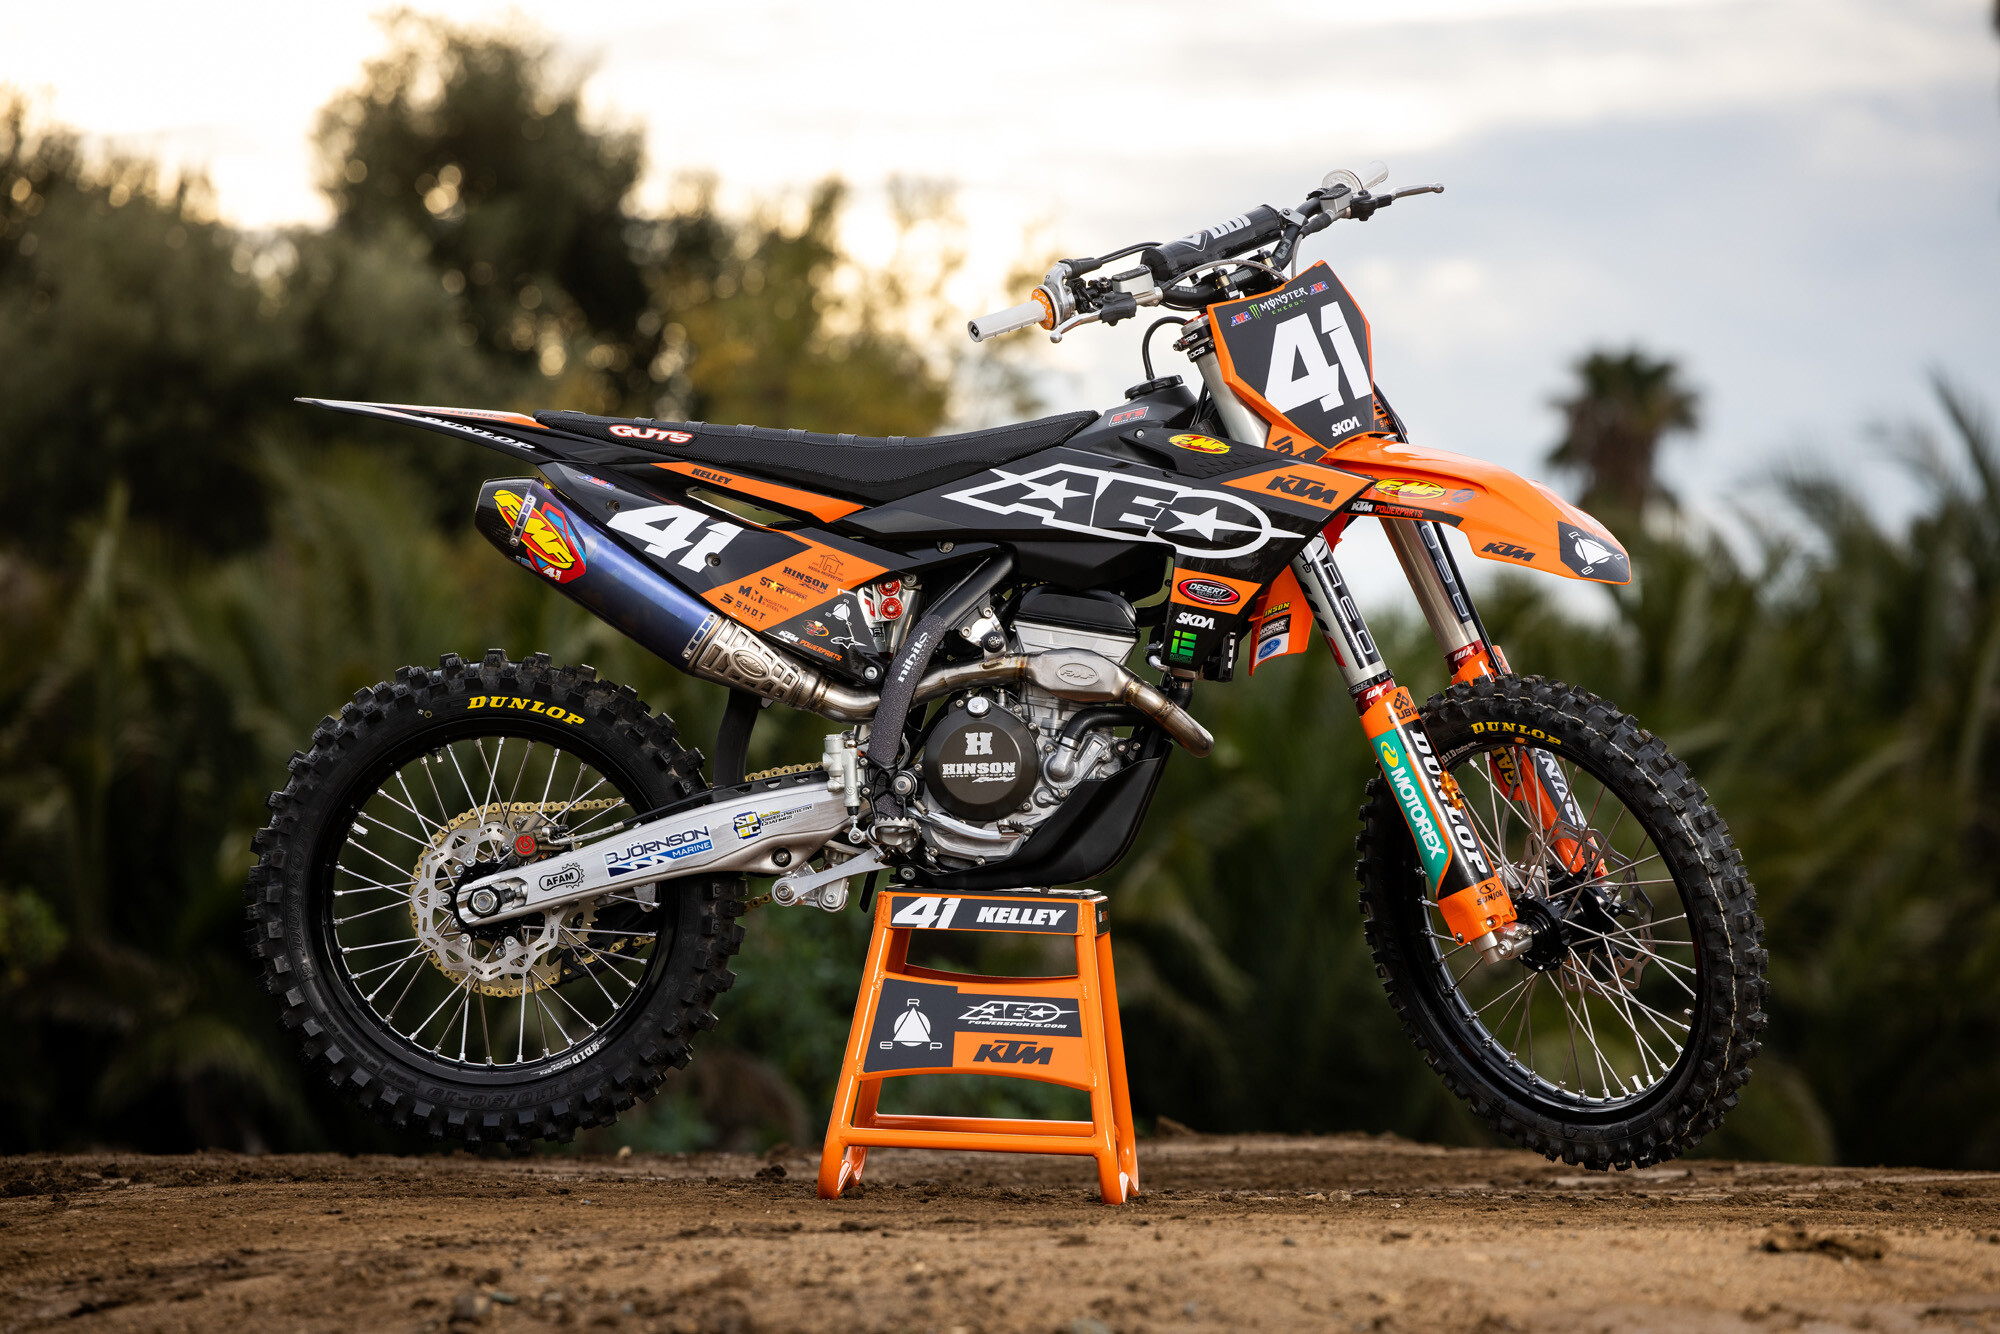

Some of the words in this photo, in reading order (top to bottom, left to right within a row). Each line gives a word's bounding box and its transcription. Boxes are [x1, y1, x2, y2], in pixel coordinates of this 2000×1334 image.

[1264, 301, 1373, 414] 41
[424, 416, 535, 449] DUNLOP
[609, 424, 693, 443] GUTS
[1331, 416, 1361, 437] SKDA
[1169, 434, 1231, 454] FMF
[691, 468, 733, 484] KELLEY
[1265, 474, 1339, 504] KTM
[1374, 478, 1447, 499] FMF
[1351, 500, 1373, 513] KTM
[1374, 504, 1423, 518] POWERPARTS
[493, 491, 576, 564] FMF
[606, 504, 744, 573] 41
[1480, 541, 1536, 562] KTM
[782, 566, 829, 590] HINSON
[1188, 583, 1227, 597] DESERT
[735, 600, 766, 620] SHOT
[1264, 602, 1290, 617] INSON
[1323, 562, 1374, 655] AEO
[1175, 611, 1215, 630] SKDA
[799, 639, 843, 661] POWERPARTS
[898, 632, 928, 683] nihilo
[467, 695, 586, 725] DUNLOP
[964, 732, 993, 756] H
[1470, 721, 1562, 746] DUNLOP
[942, 762, 1016, 775] HINSON
[1390, 766, 1446, 861] MOTOREX
[605, 826, 709, 864] BJÖRNSON
[672, 840, 711, 858] MARINE
[546, 871, 574, 887] AFAM
[1476, 889, 1504, 906] SUNJOE
[891, 897, 962, 928] 41
[976, 907, 1067, 926] KELLEY
[968, 1020, 1067, 1029] POWERSPORTS.COM
[972, 1039, 1054, 1065] KTM
